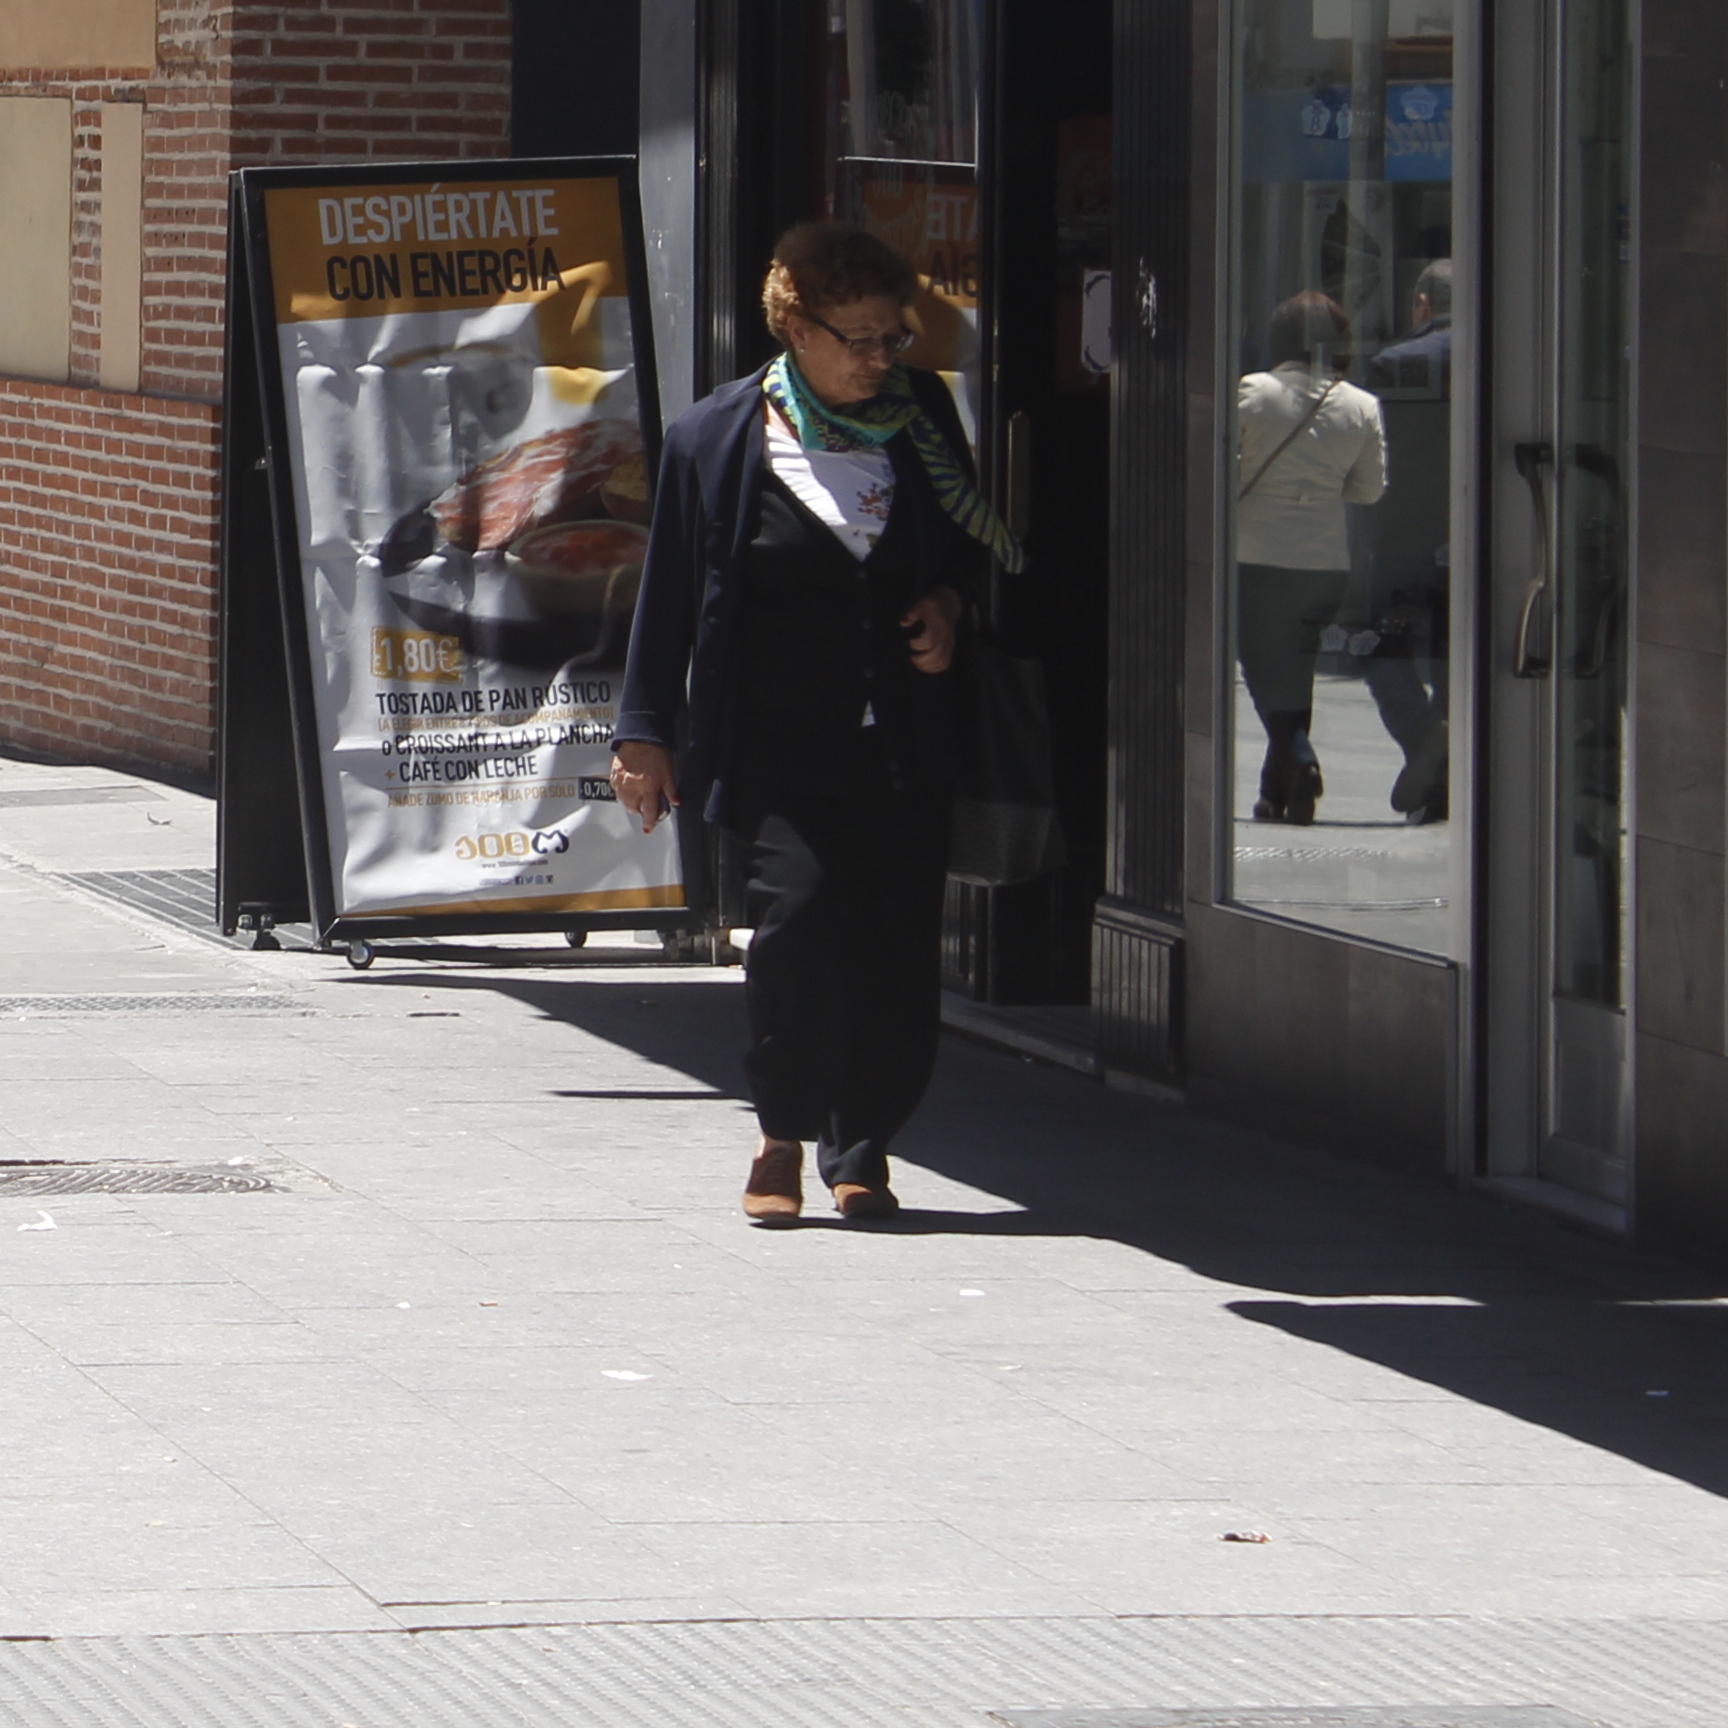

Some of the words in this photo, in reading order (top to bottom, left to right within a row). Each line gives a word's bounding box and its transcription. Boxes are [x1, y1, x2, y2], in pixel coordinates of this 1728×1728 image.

[317, 183, 560, 246] DESPIÉRTATE
[325, 251, 403, 302] CON
[412, 237, 567, 299] ENERGÍA
[379, 636, 455, 677] 1,80€
[376, 692, 458, 715] TOSTADA
[461, 690, 485, 713] DE
[489, 687, 528, 711] PAN
[532, 680, 612, 708] RÚSTICO
[395, 730, 492, 757] CROISSANT
[493, 731, 508, 752] A
[510, 729, 532, 752] LA
[534, 723, 616, 748] PLANCHA
[399, 756, 442, 783] CAFÉ
[444, 760, 481, 782] CON
[484, 755, 539, 779] LECHE
[455, 791, 470, 806] DE
[524, 786, 546, 802] POR
